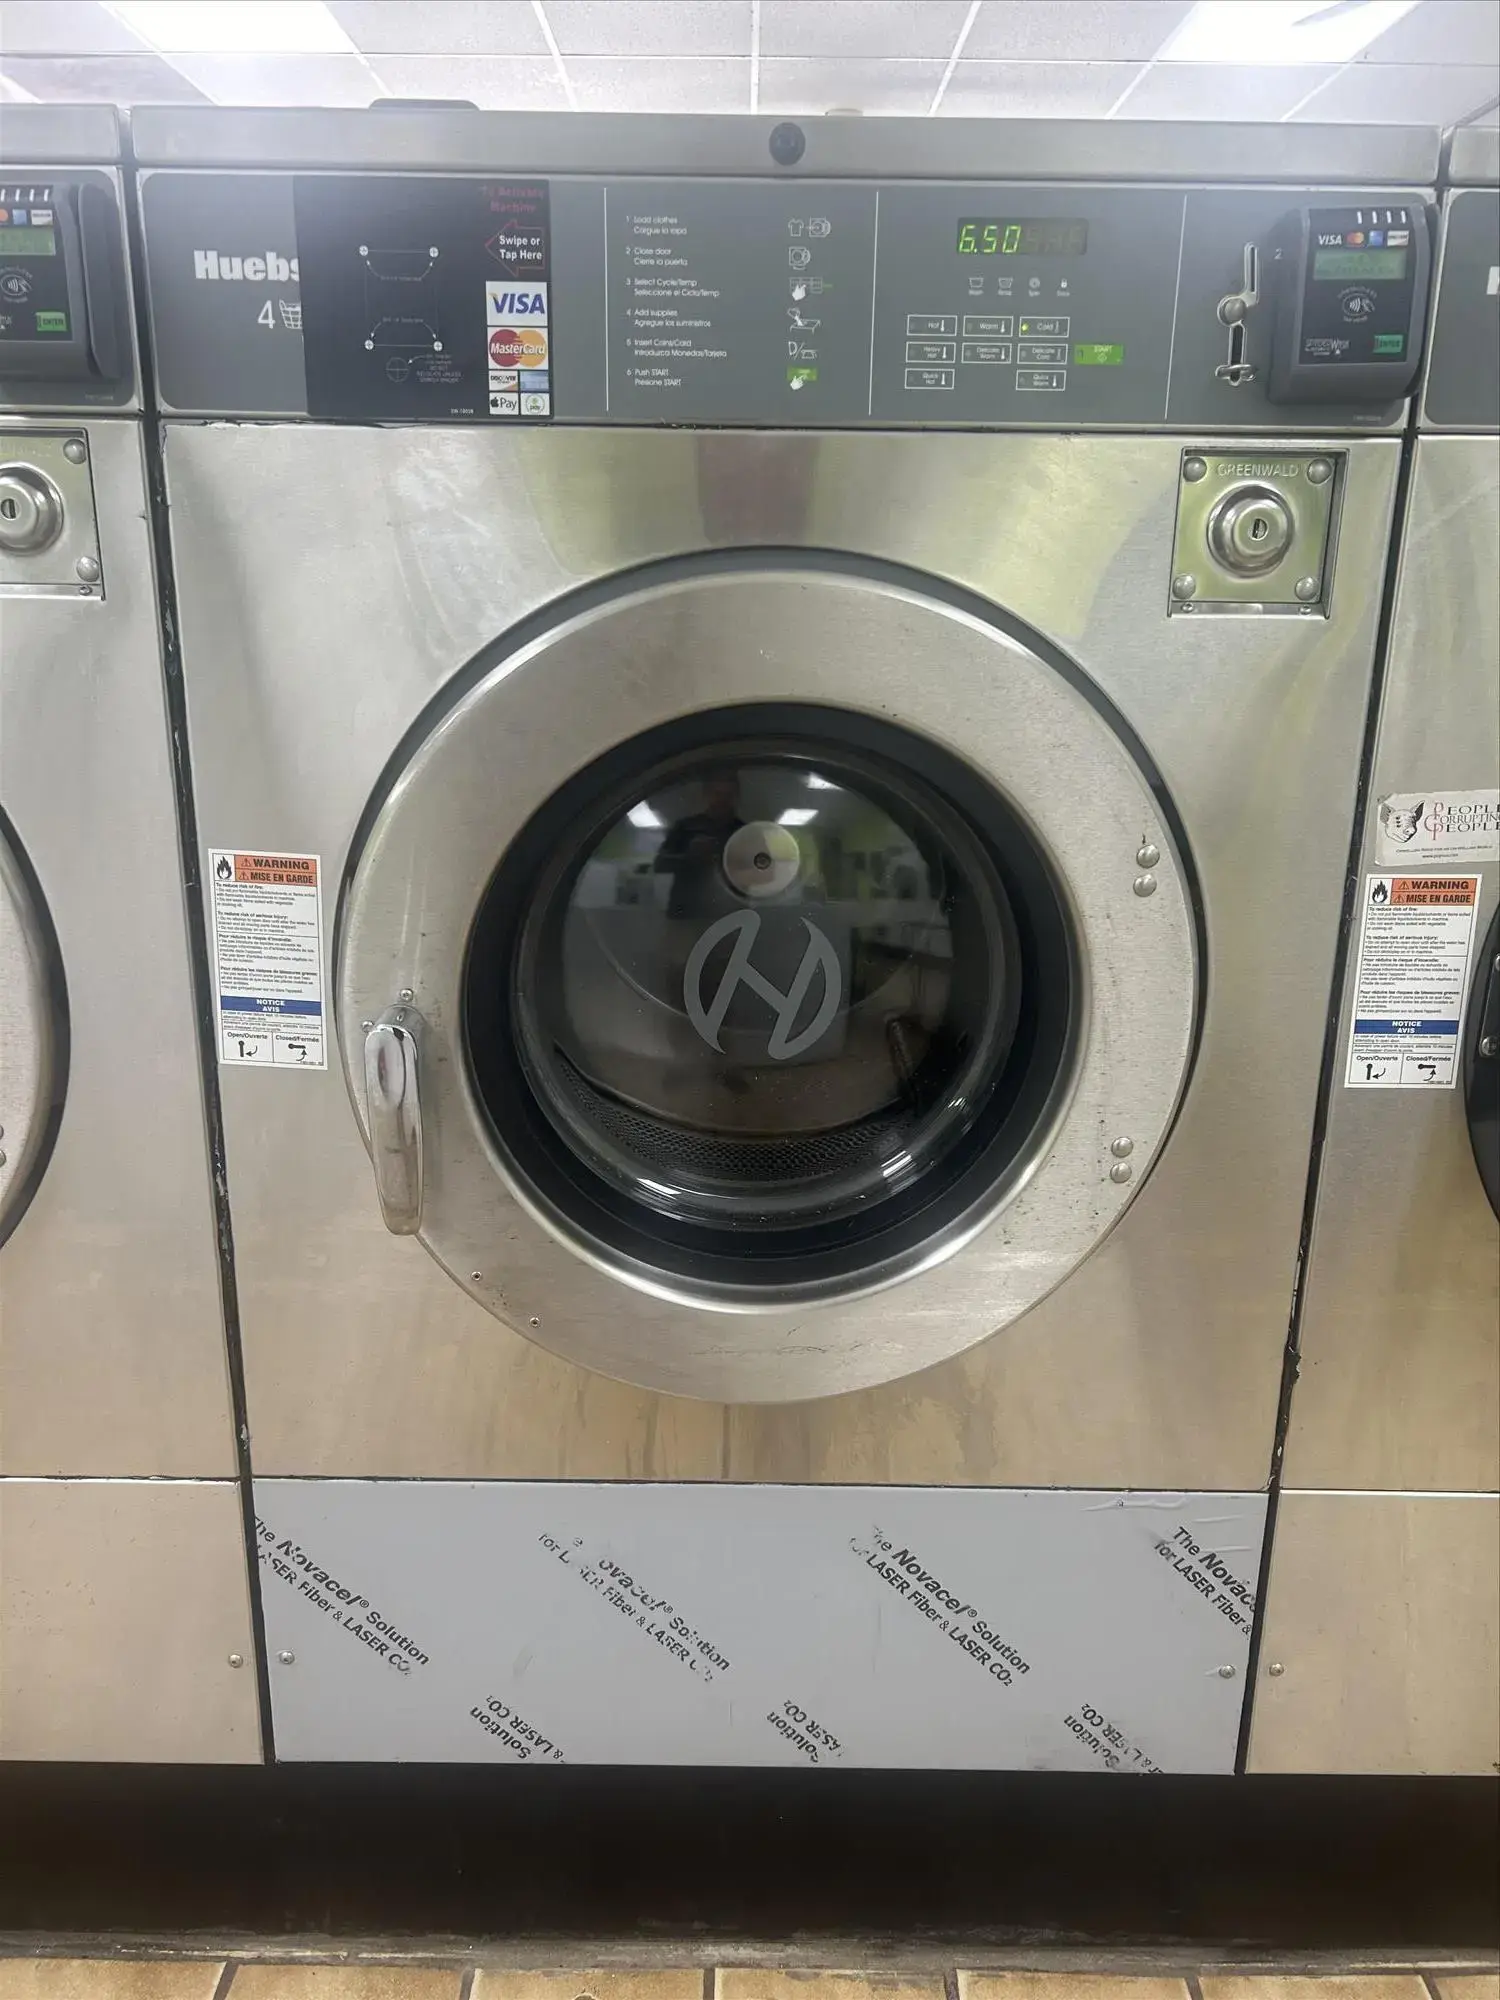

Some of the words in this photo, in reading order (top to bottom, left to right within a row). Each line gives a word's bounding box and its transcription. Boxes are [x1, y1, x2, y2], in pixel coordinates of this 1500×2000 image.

[499, 235, 528, 247] Swipe
[530, 238, 540, 246] or
[958, 225, 1022, 253] 6.50
[1318, 234, 1343, 246] VISA
[499, 249, 518, 261] Tap
[519, 250, 542, 260] Here
[489, 293, 545, 314] VISA
[257, 300, 276, 329] 4
[490, 342, 546, 354] MasterCard
[500, 397, 517, 411] Pay
[1217, 463, 1299, 477] GREENWALD
[253, 858, 310, 870] WARNING
[250, 871, 271, 881] MISE
[273, 872, 284, 882] EN
[286, 873, 313, 884] GARDE
[1411, 880, 1469, 890] WARNING
[1406, 894, 1427, 903] MISE
[1429, 894, 1441, 903] EN
[1443, 894, 1471, 903] GARDE
[227, 1032, 268, 1040] Open/Ouverte
[275, 1035, 320, 1043] Closed/Fermée
[1173, 1526, 1200, 1556] The
[1172, 1557, 1216, 1598] LASER
[1212, 1594, 1246, 1625] Fiber
[1241, 1624, 1252, 1635] &
[866, 1553, 910, 1595] LASER
[907, 1590, 943, 1622] Fiber
[939, 1620, 950, 1632] &
[948, 1626, 992, 1667] LASER
[298, 1580, 336, 1612] Fiber
[332, 1610, 343, 1622] &
[342, 1616, 390, 1656] LASER
[602, 1587, 637, 1617] Fiber
[635, 1616, 646, 1628] &
[646, 1623, 690, 1662] LASER
[366, 1611, 429, 1665] Solution
[972, 1620, 1030, 1674] Solution
[469, 1707, 531, 1760] Solution
[509, 1715, 554, 1754] LASER
[553, 1749, 564, 1760] &
